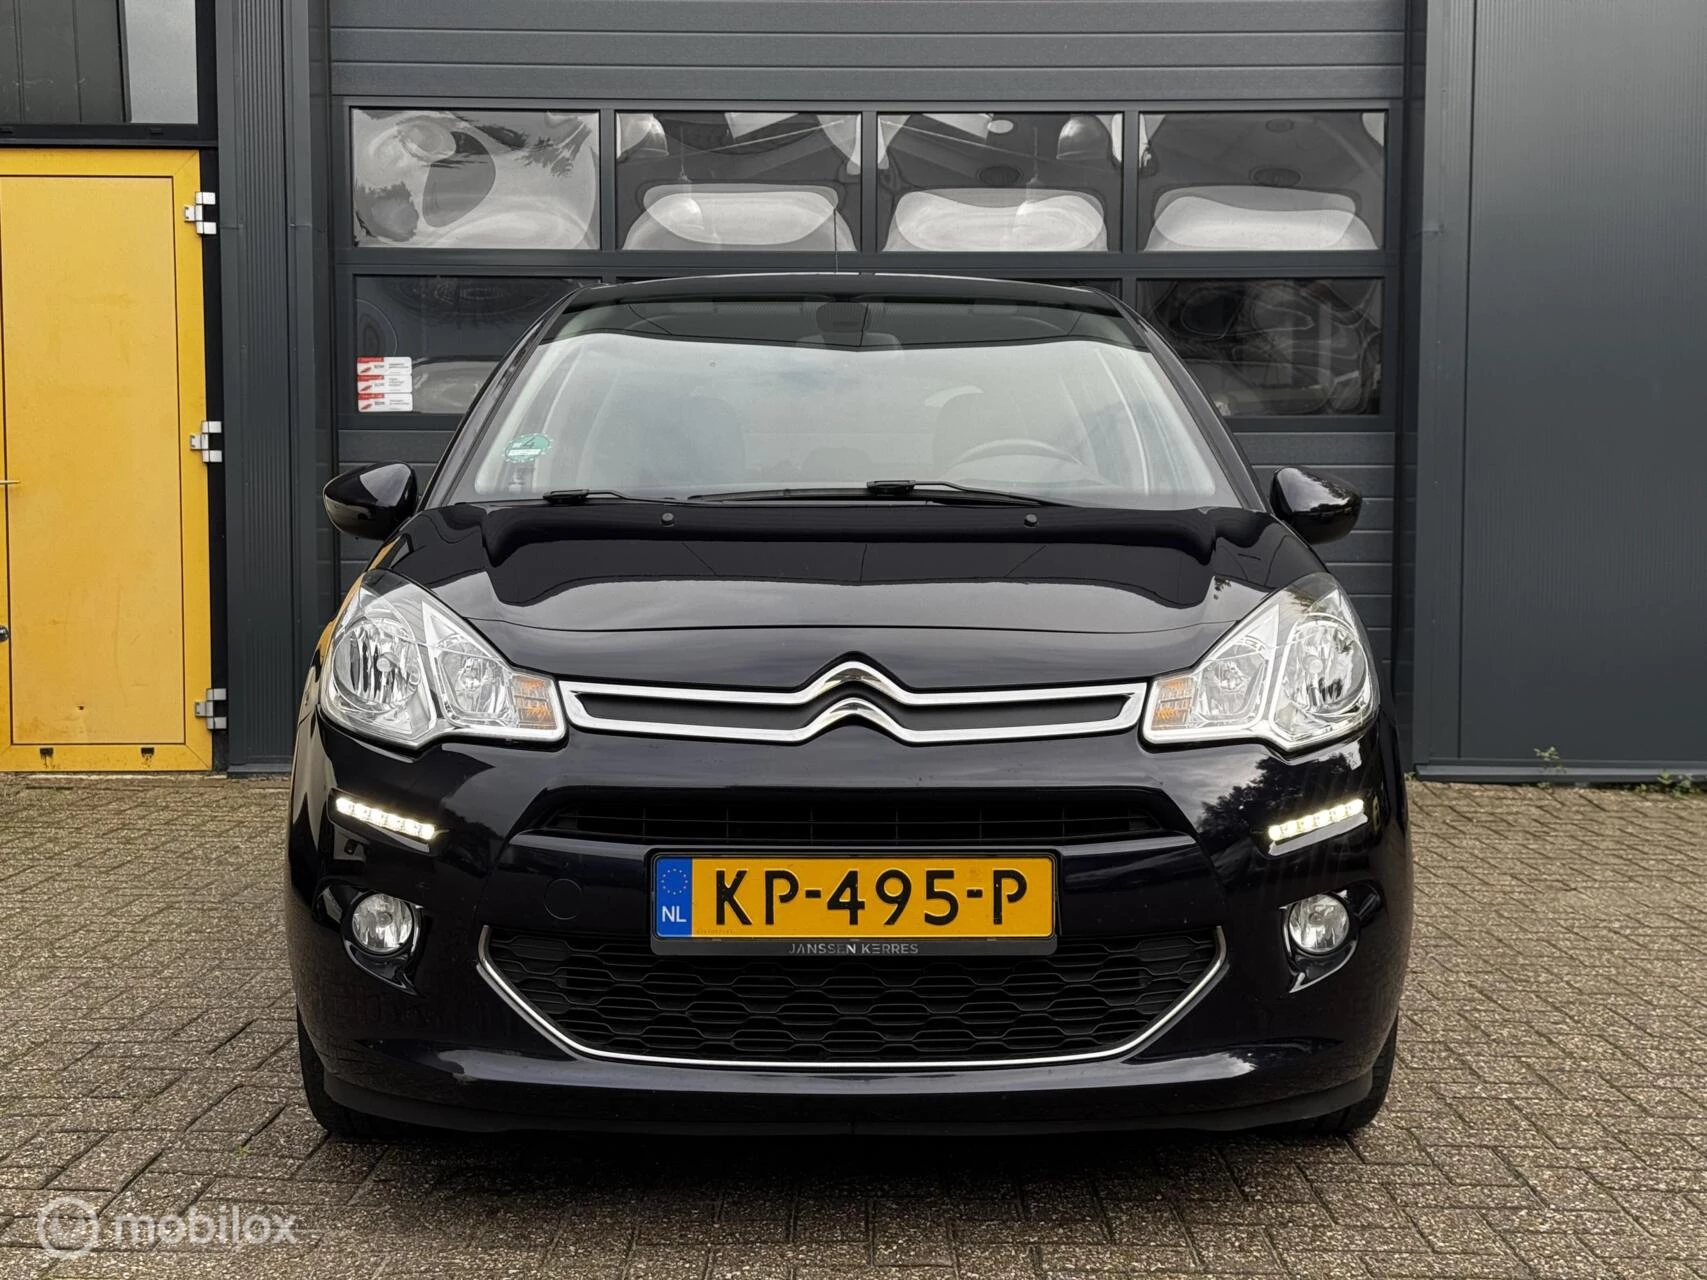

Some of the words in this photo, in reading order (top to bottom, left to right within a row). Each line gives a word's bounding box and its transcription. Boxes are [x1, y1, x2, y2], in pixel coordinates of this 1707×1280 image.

[715, 869, 1028, 926] KP-495-P
[661, 905, 687, 922] NL
[789, 943, 856, 954] JANSSEN
[861, 943, 919, 954] KERRES
